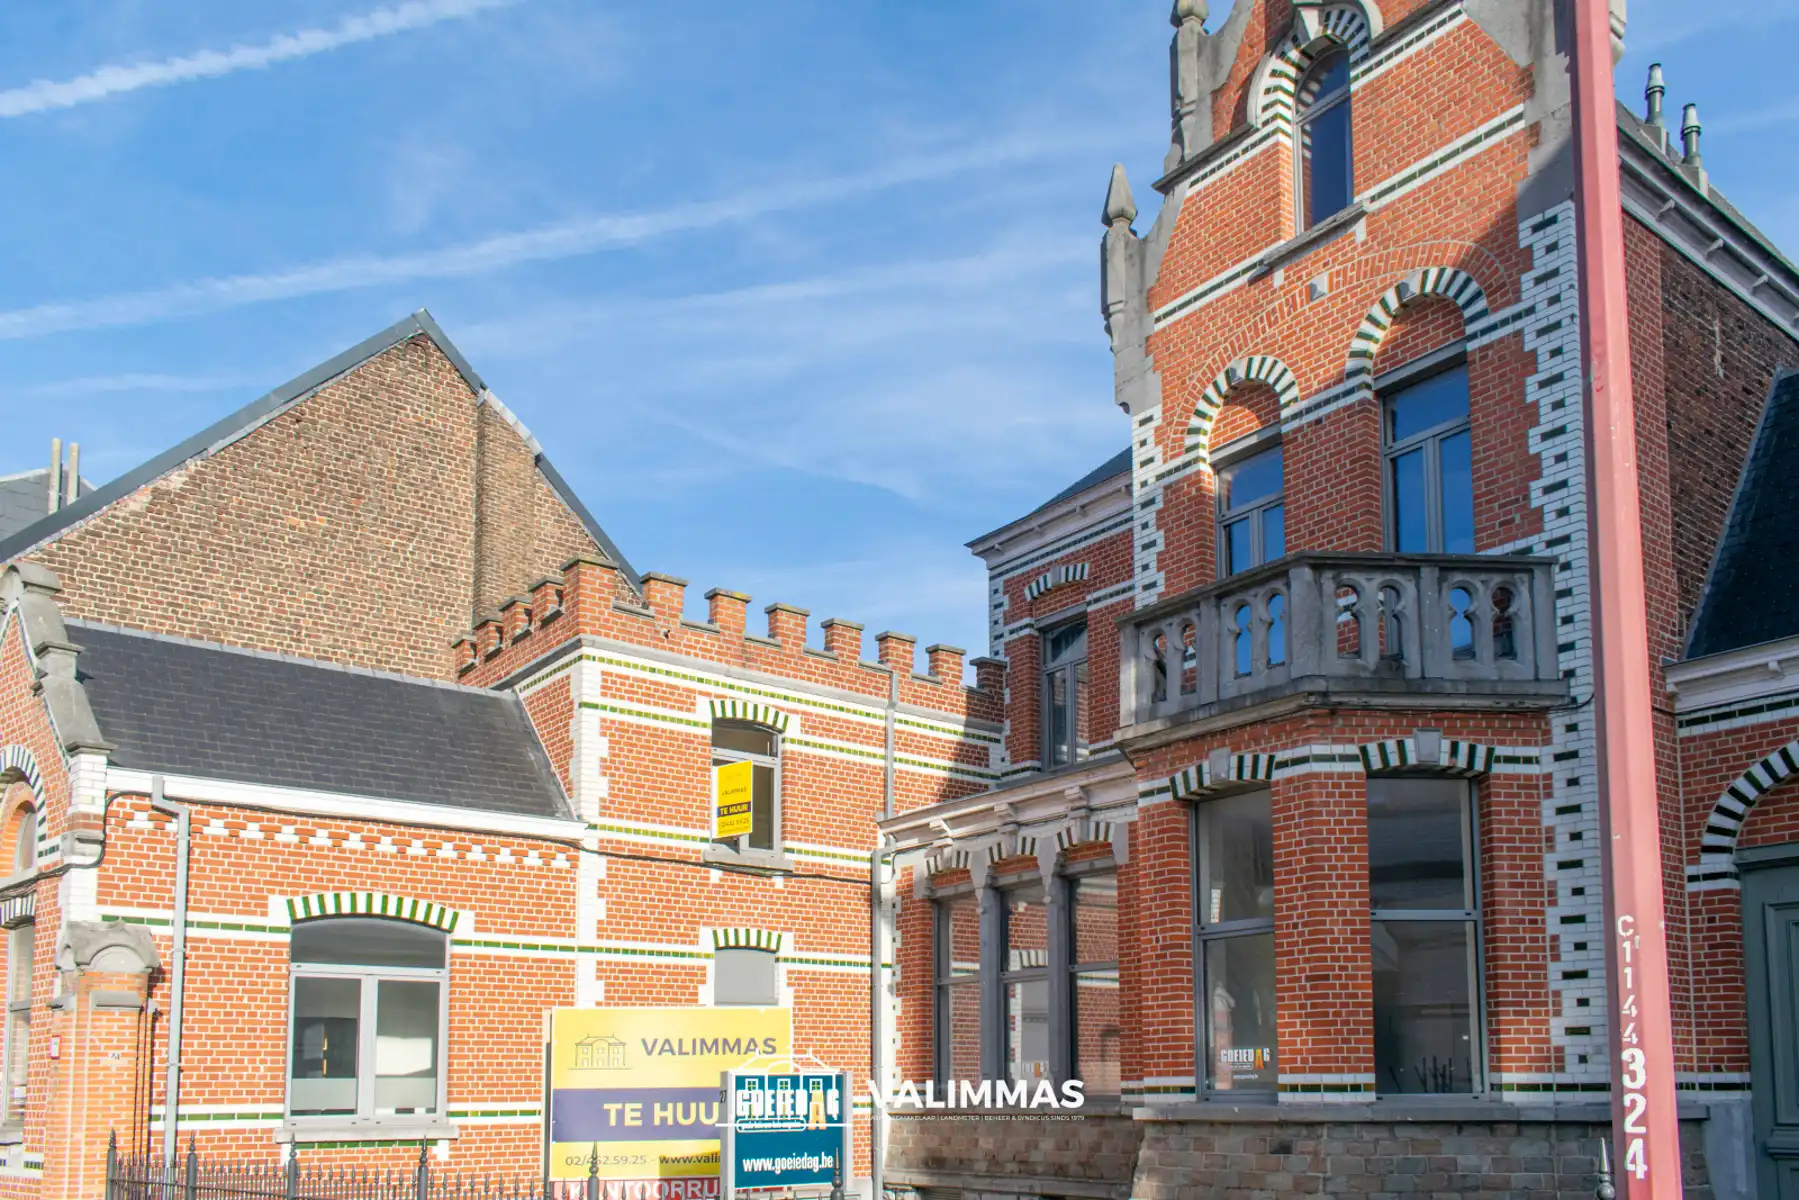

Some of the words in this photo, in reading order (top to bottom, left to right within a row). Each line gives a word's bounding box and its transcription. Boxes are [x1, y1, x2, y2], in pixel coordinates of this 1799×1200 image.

[720, 807, 729, 815] TE
[729, 803, 748, 813] HUUR
[641, 1037, 776, 1056] VALIMMAS
[603, 1102, 643, 1126] TE
[659, 1151, 720, 1164] www.vali
[742, 1151, 833, 1175] www.goeiedag.be
[568, 1179, 719, 1199] KNTOORRU
